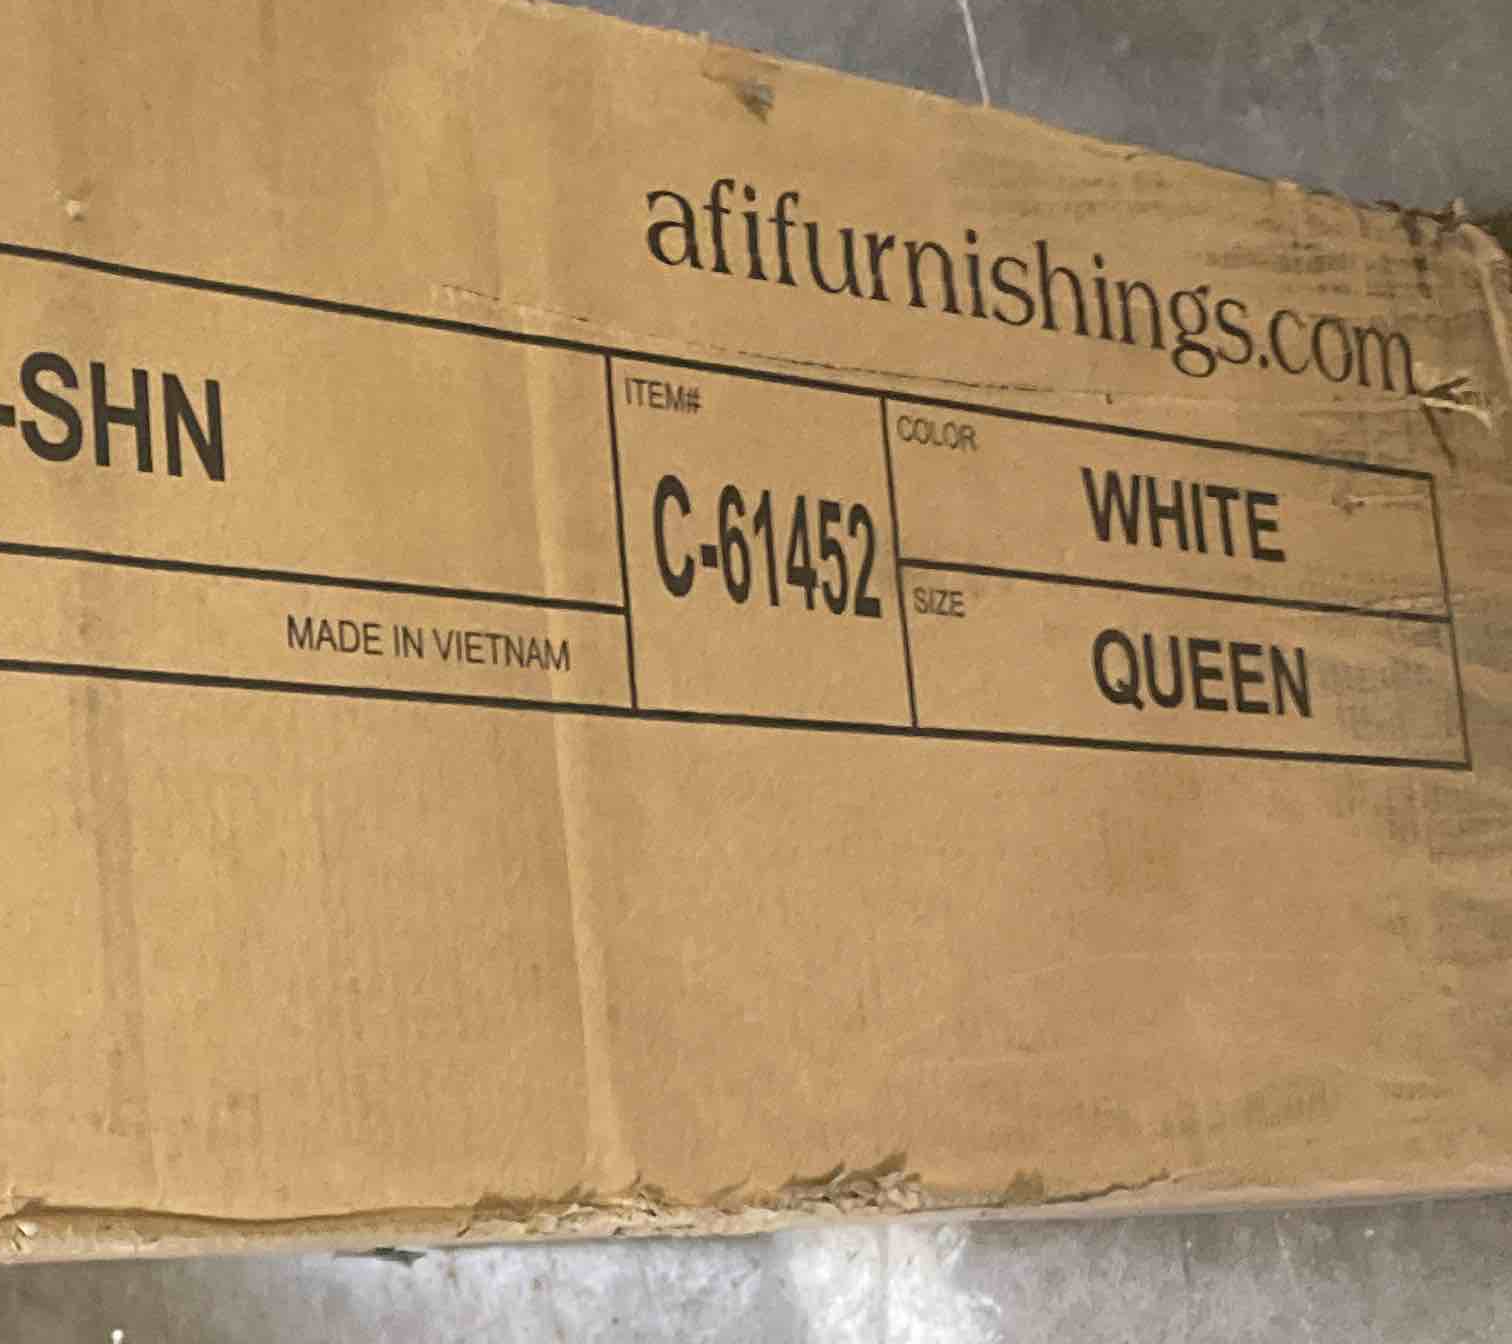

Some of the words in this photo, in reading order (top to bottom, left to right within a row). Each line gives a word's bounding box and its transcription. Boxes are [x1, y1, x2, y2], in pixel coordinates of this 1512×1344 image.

[645, 177, 1423, 397] afifurnishings.com
[623, 376, 704, 416] ITEM#
[895, 413, 979, 453] COLOR
[651, 473, 885, 621] C-61452
[1081, 466, 1288, 564] WHITE
[912, 586, 968, 621] SIZE
[286, 612, 385, 656] MADE
[392, 624, 425, 660] IN
[431, 626, 572, 673] VIETNAM
[1092, 628, 1314, 719] QUEEN
